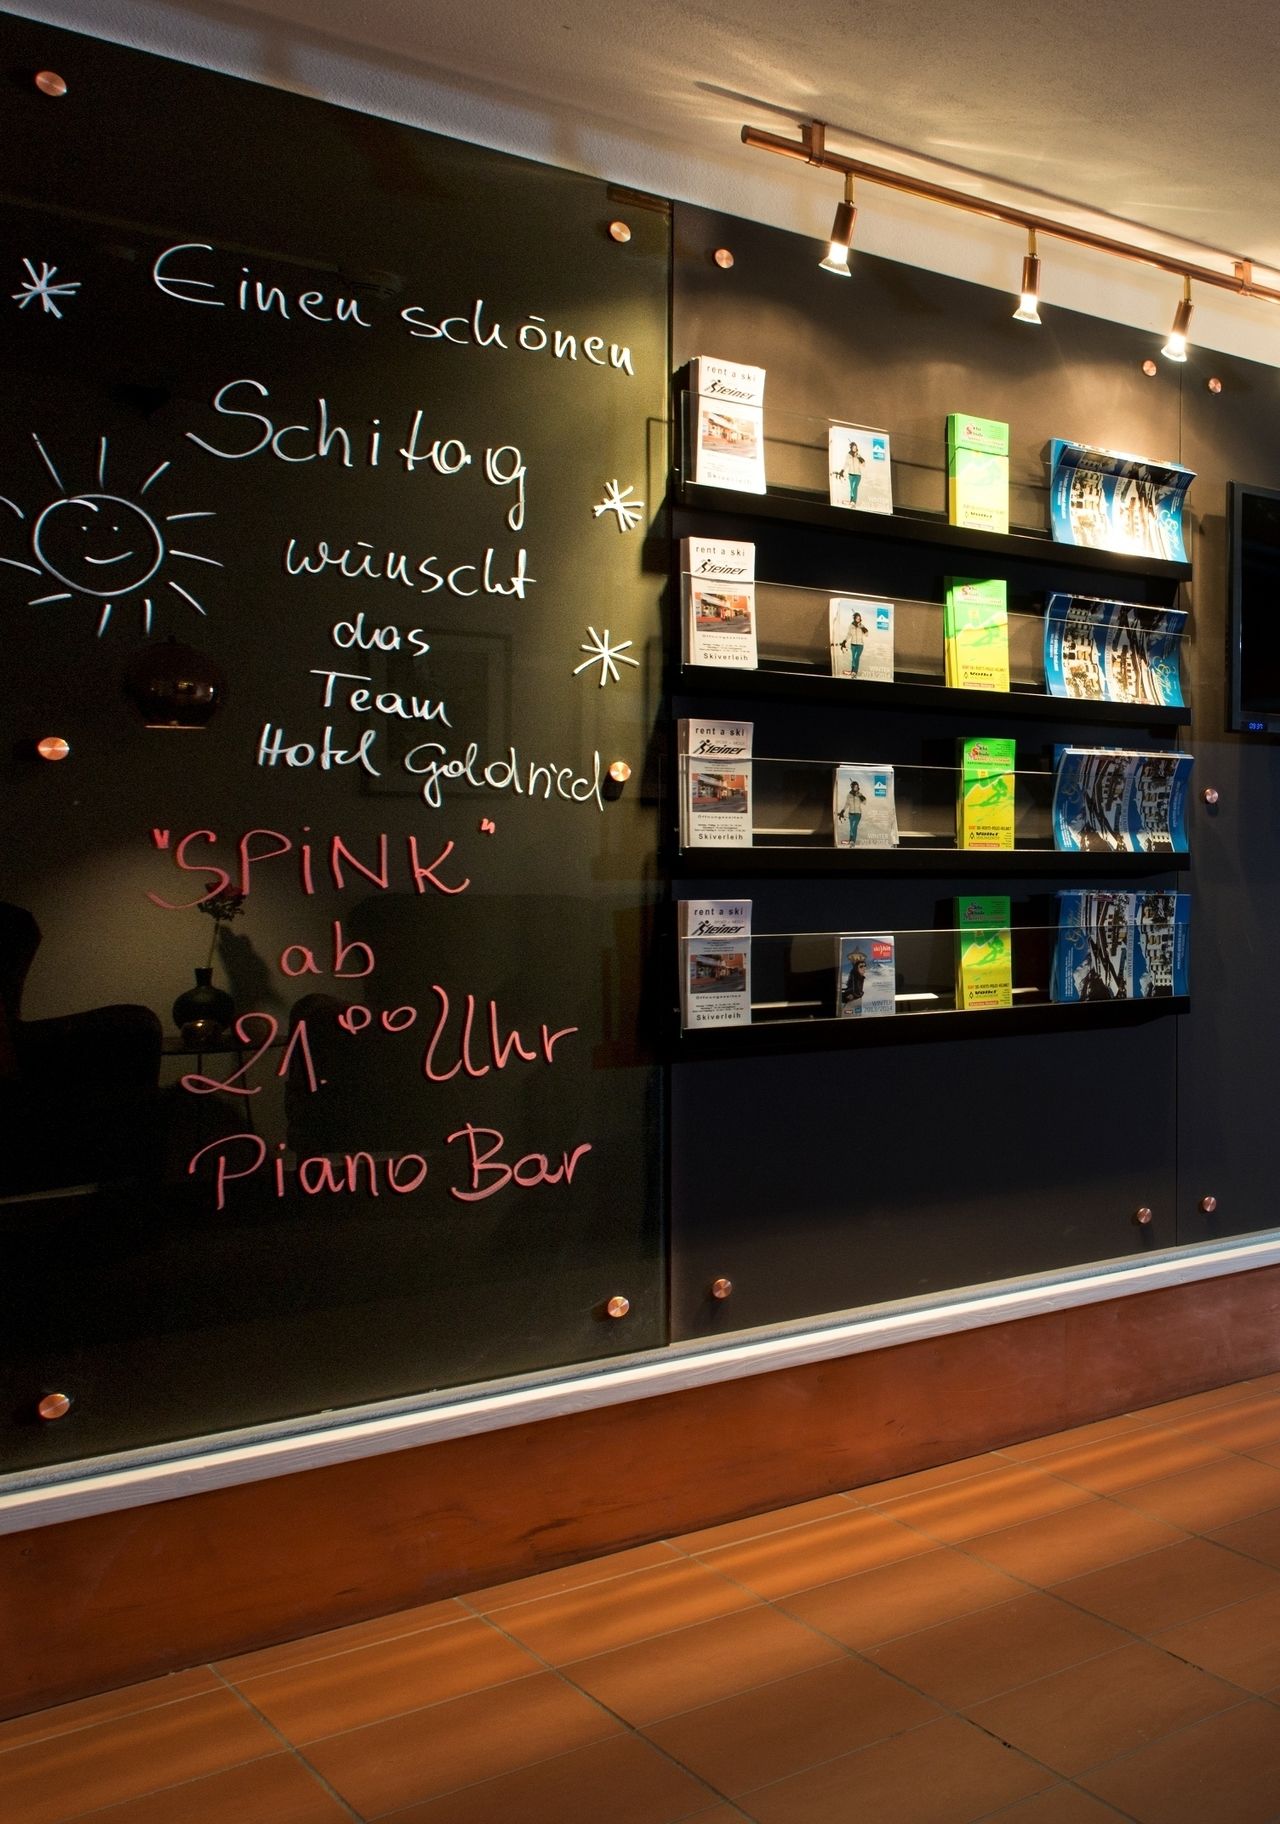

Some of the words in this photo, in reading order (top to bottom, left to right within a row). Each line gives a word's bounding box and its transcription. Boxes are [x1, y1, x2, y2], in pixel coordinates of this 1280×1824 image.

[153, 243, 371, 327] Einen
[401, 299, 635, 376] schönen
[706, 364, 728, 376] rent
[186, 379, 527, 531] Schitag
[286, 537, 537, 600] wünscht
[695, 545, 717, 555] rent
[730, 548, 746, 557] ski
[333, 613, 430, 656] das
[703, 652, 750, 662] Skiverleih
[310, 669, 453, 728] Team
[695, 727, 716, 737] rent
[730, 727, 745, 737] ski
[257, 723, 380, 777] Hotel
[404, 742, 605, 812] Goldried
[698, 832, 744, 841] Skiverleih
[694, 907, 715, 917] rent
[728, 907, 744, 916] ski
[281, 921, 375, 977] ab
[425, 985, 578, 1081] Uhr
[696, 1012, 742, 1022] Skiverleih
[188, 1134, 428, 1210] Piano
[446, 1122, 592, 1201] Bar
